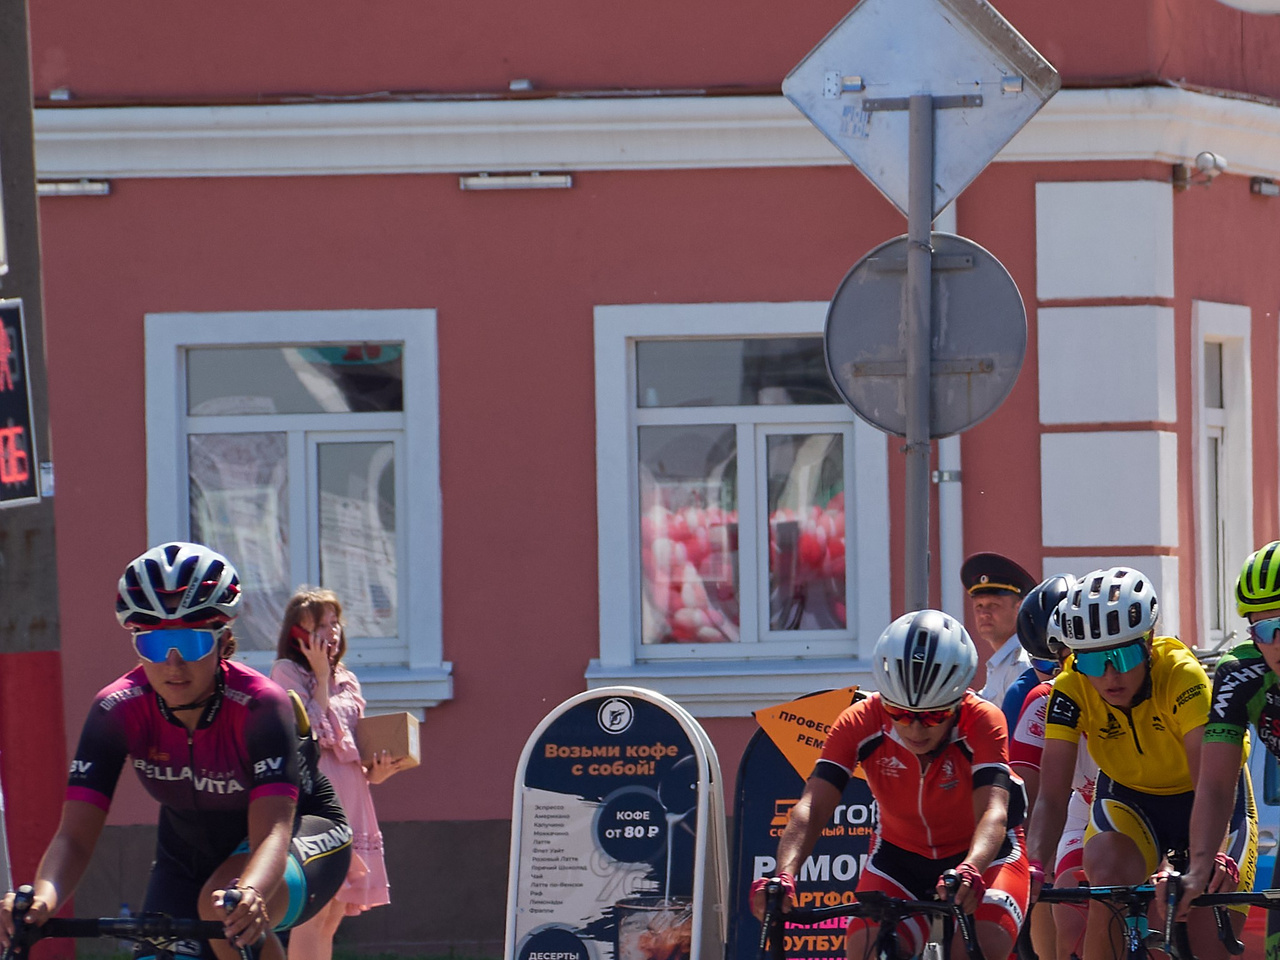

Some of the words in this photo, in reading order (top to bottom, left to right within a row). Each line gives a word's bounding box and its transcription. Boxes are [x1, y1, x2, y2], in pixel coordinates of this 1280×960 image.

[544, 743, 620, 759] Возьми
[626, 741, 679, 761] кофе
[132, 759, 193, 781] BELLA
[253, 757, 283, 774] BV
[571, 763, 583, 776] с
[588, 760, 656, 776] собой!
[193, 776, 246, 795] VITA
[616, 811, 650, 821] КОФЕ
[623, 826, 644, 839] 80
[647, 826, 659, 838] ₽
[753, 854, 868, 883] РМО
[1242, 848, 1256, 893] ACING
